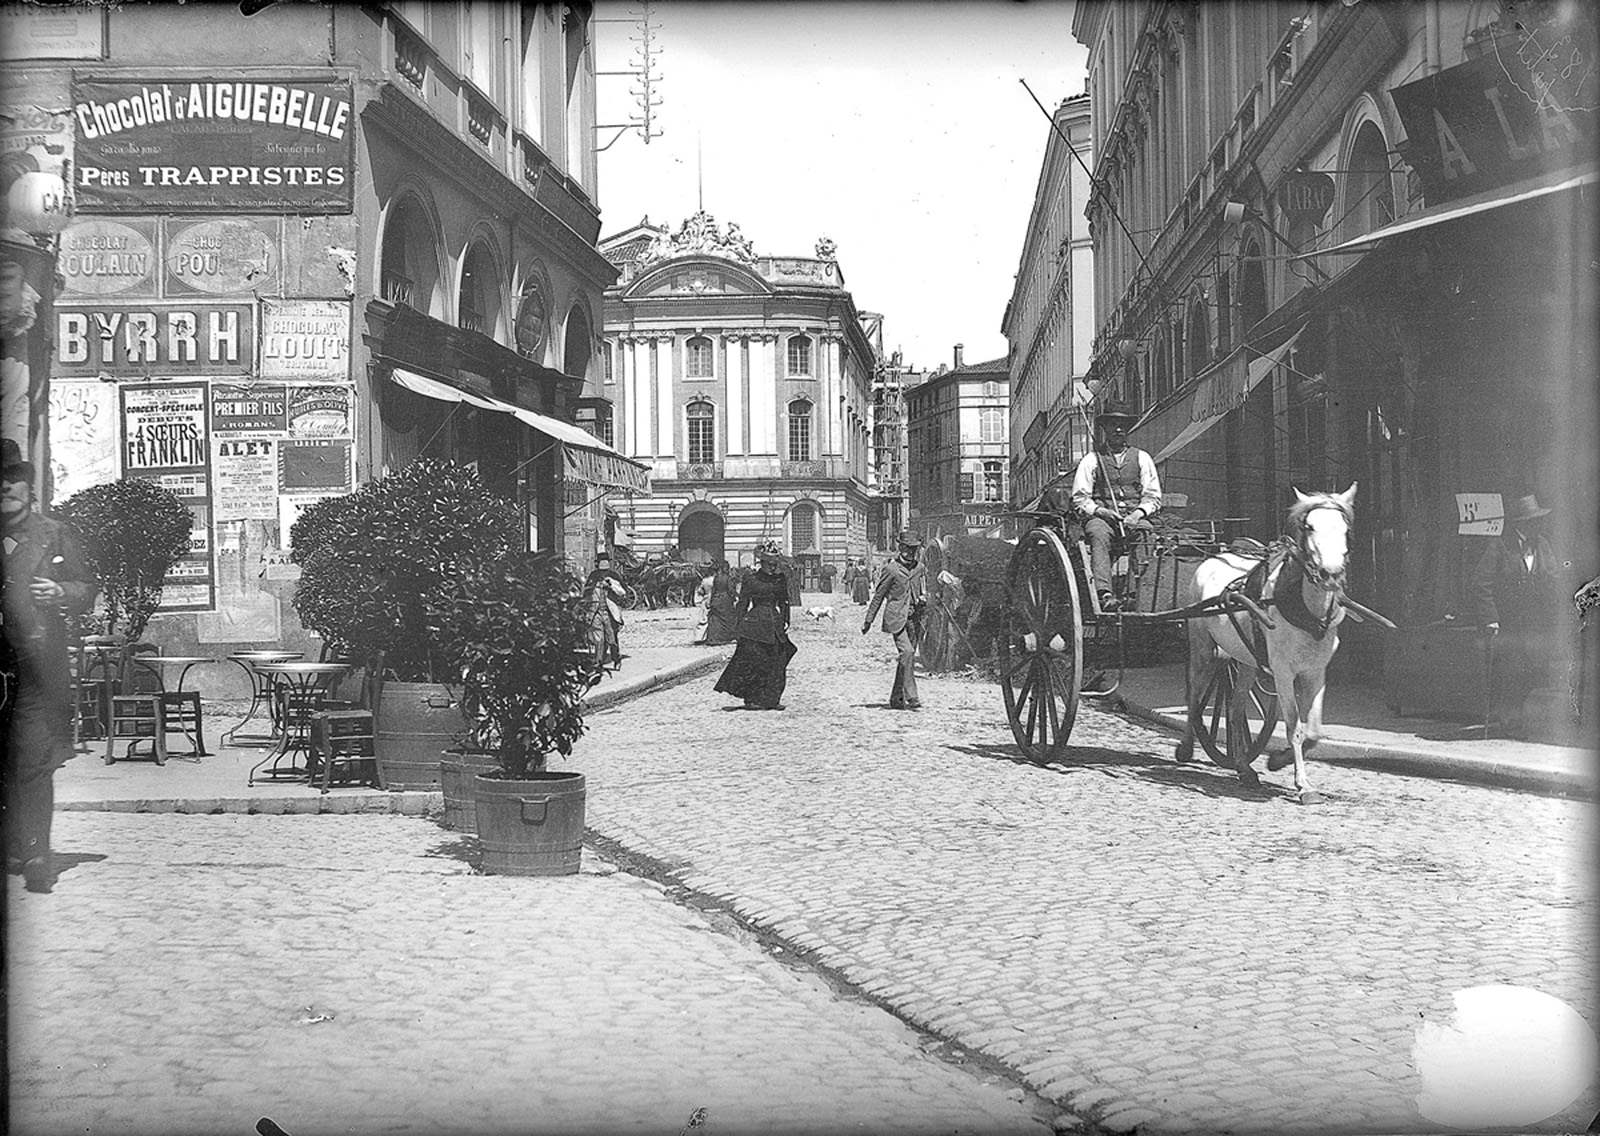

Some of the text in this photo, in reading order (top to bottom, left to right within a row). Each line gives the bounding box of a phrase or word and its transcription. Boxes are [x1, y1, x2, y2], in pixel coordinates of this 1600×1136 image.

[76, 84, 172, 139] Chocolat
[138, 166, 345, 186] TRAPPISTES
[59, 311, 238, 364] BYRRH
[265, 336, 346, 360] LOUIT
[214, 401, 284, 416] PREMIER FILS
[135, 425, 144, 441] 4
[128, 439, 205, 468] FRANKLIN
[219, 441, 272, 456] ALET
